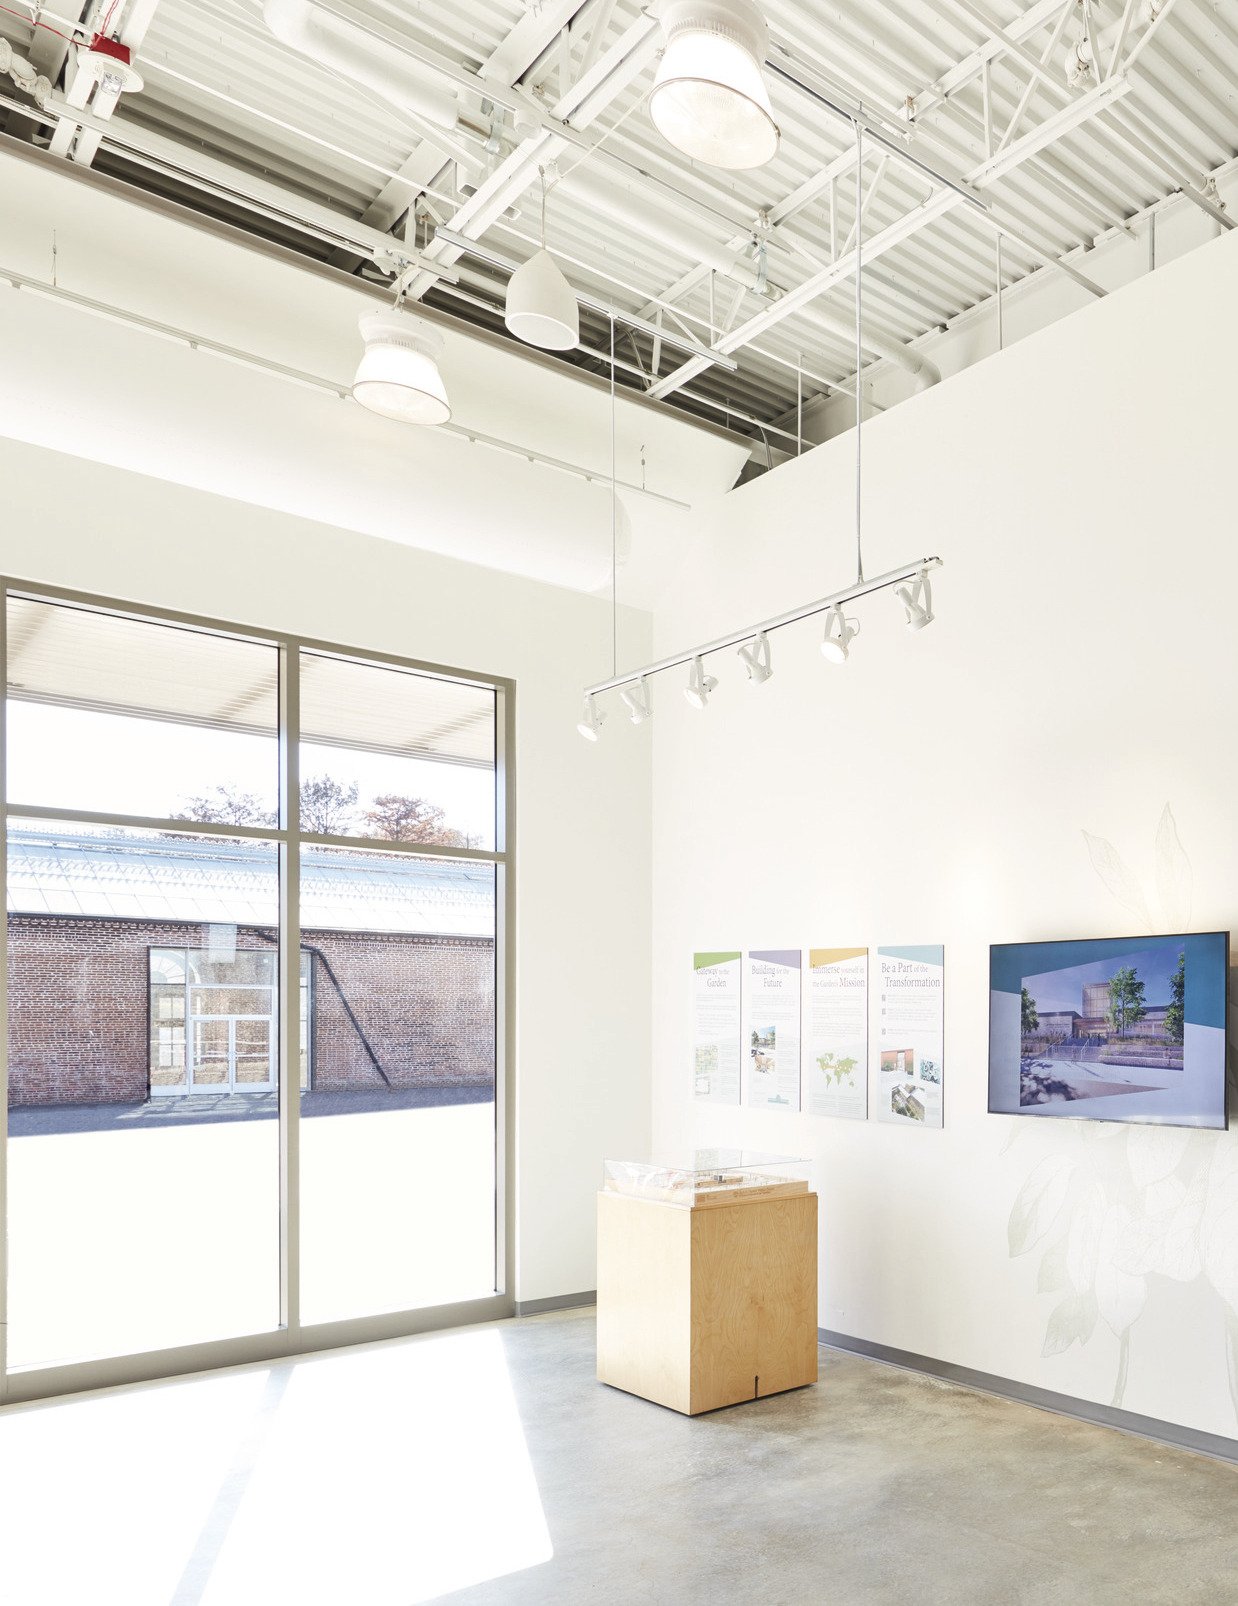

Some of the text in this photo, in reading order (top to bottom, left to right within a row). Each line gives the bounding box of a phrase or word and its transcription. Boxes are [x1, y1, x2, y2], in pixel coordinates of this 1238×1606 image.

[751, 965, 776, 977] Building
[881, 962, 891, 973] Be
[891, 965, 896, 973] a
[897, 962, 913, 973] Part
[919, 964, 928, 973] the
[706, 977, 727, 988] Garden
[763, 977, 783, 988] Future
[839, 977, 866, 988] Mission
[885, 976, 941, 988] Transformation
